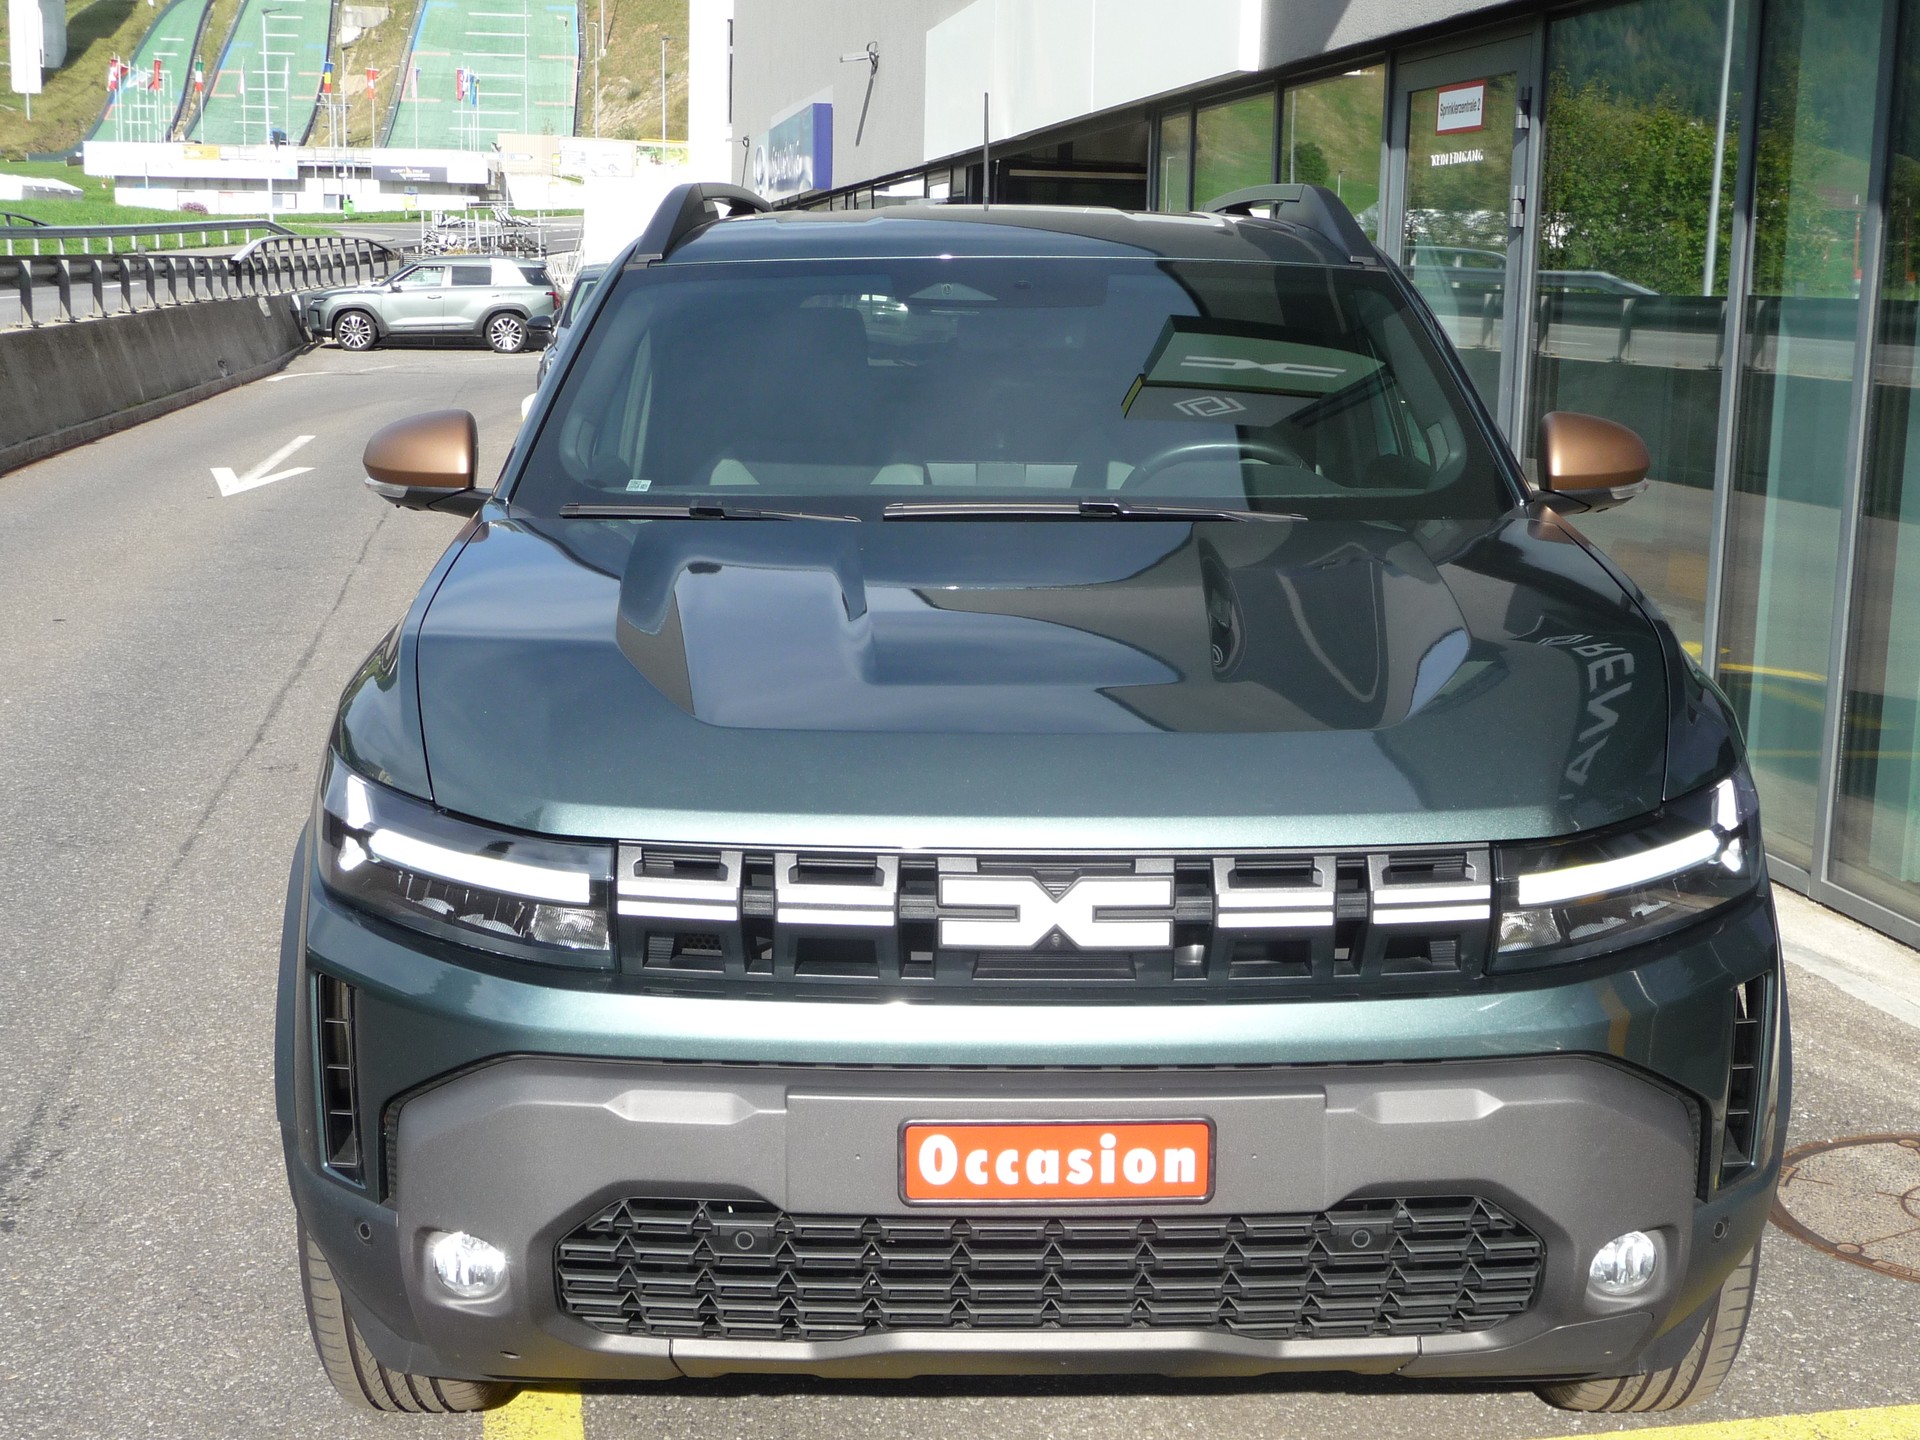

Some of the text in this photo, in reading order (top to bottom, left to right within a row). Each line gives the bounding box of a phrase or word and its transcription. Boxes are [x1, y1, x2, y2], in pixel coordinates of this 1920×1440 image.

[1440, 98, 1481, 119] Sprinklerzentrale 2
[1430, 149, 1484, 167] KEIN EINGANG
[918, 1132, 1196, 1186] Occasion
